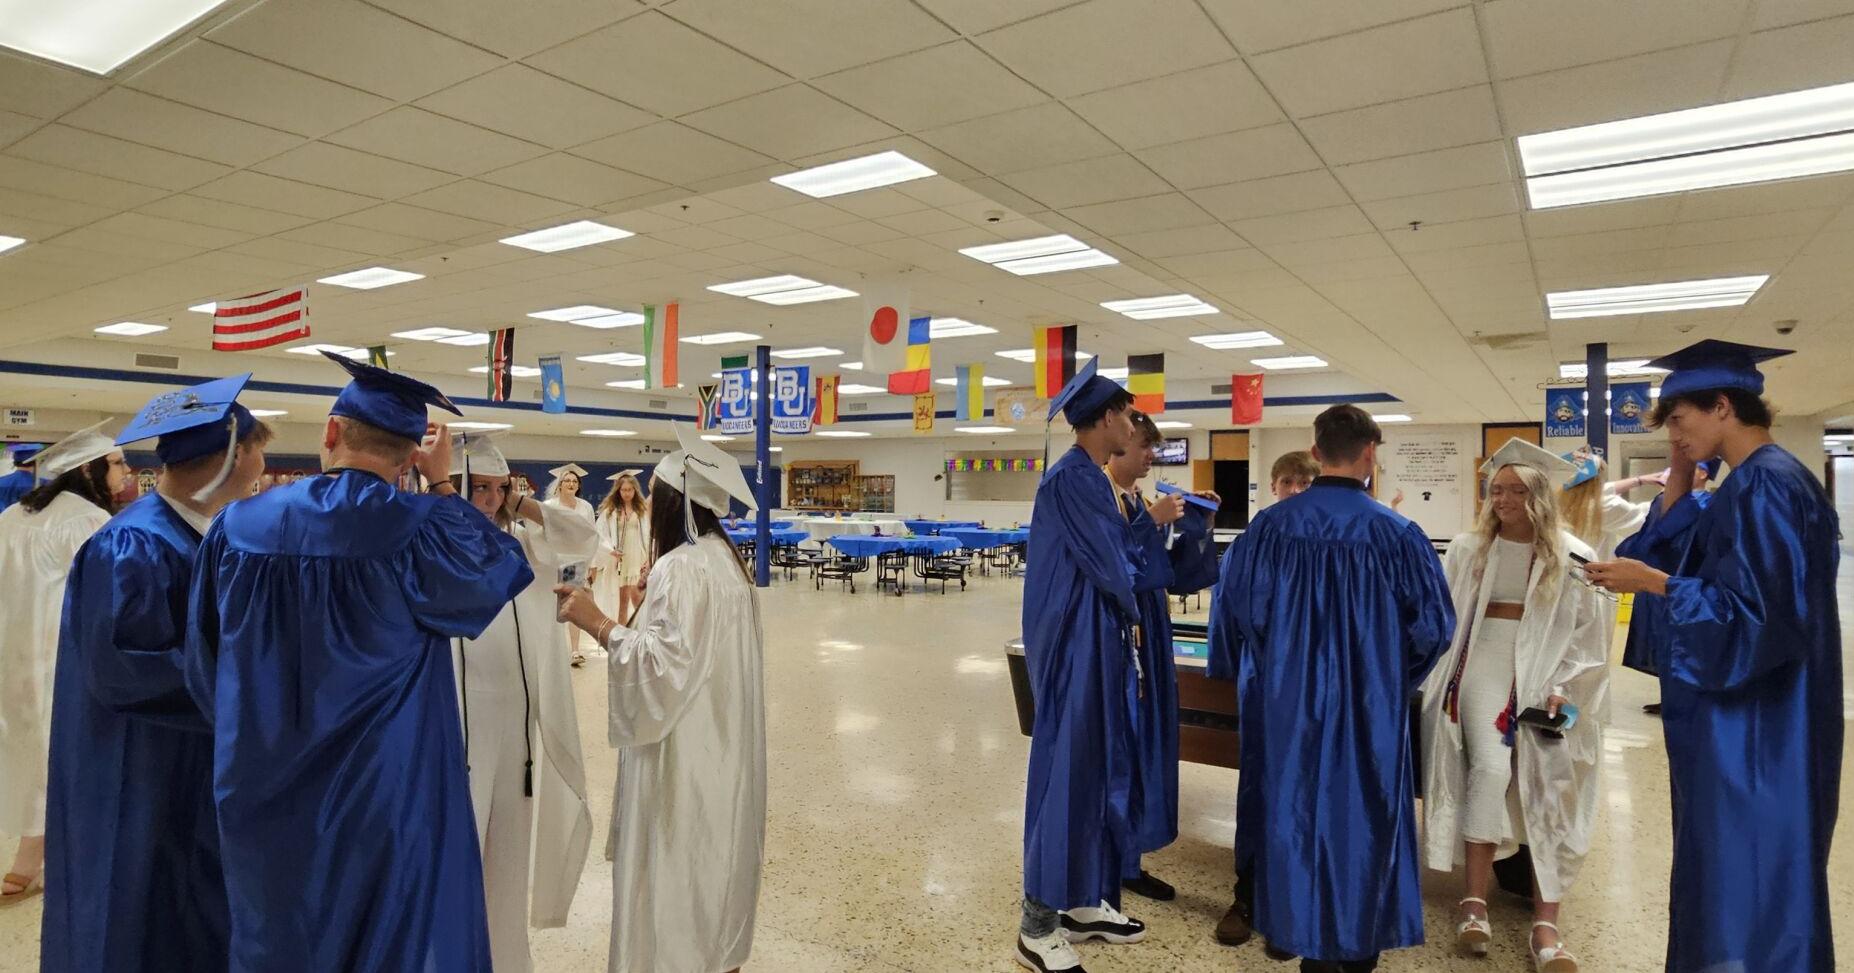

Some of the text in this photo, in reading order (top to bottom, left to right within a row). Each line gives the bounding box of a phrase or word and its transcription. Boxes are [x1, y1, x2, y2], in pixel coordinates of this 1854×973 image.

[10, 409, 29, 417] MAIN
[11, 417, 28, 425] GYM
[1547, 424, 1583, 436] Reliable
[1612, 422, 1649, 433] Innovati
